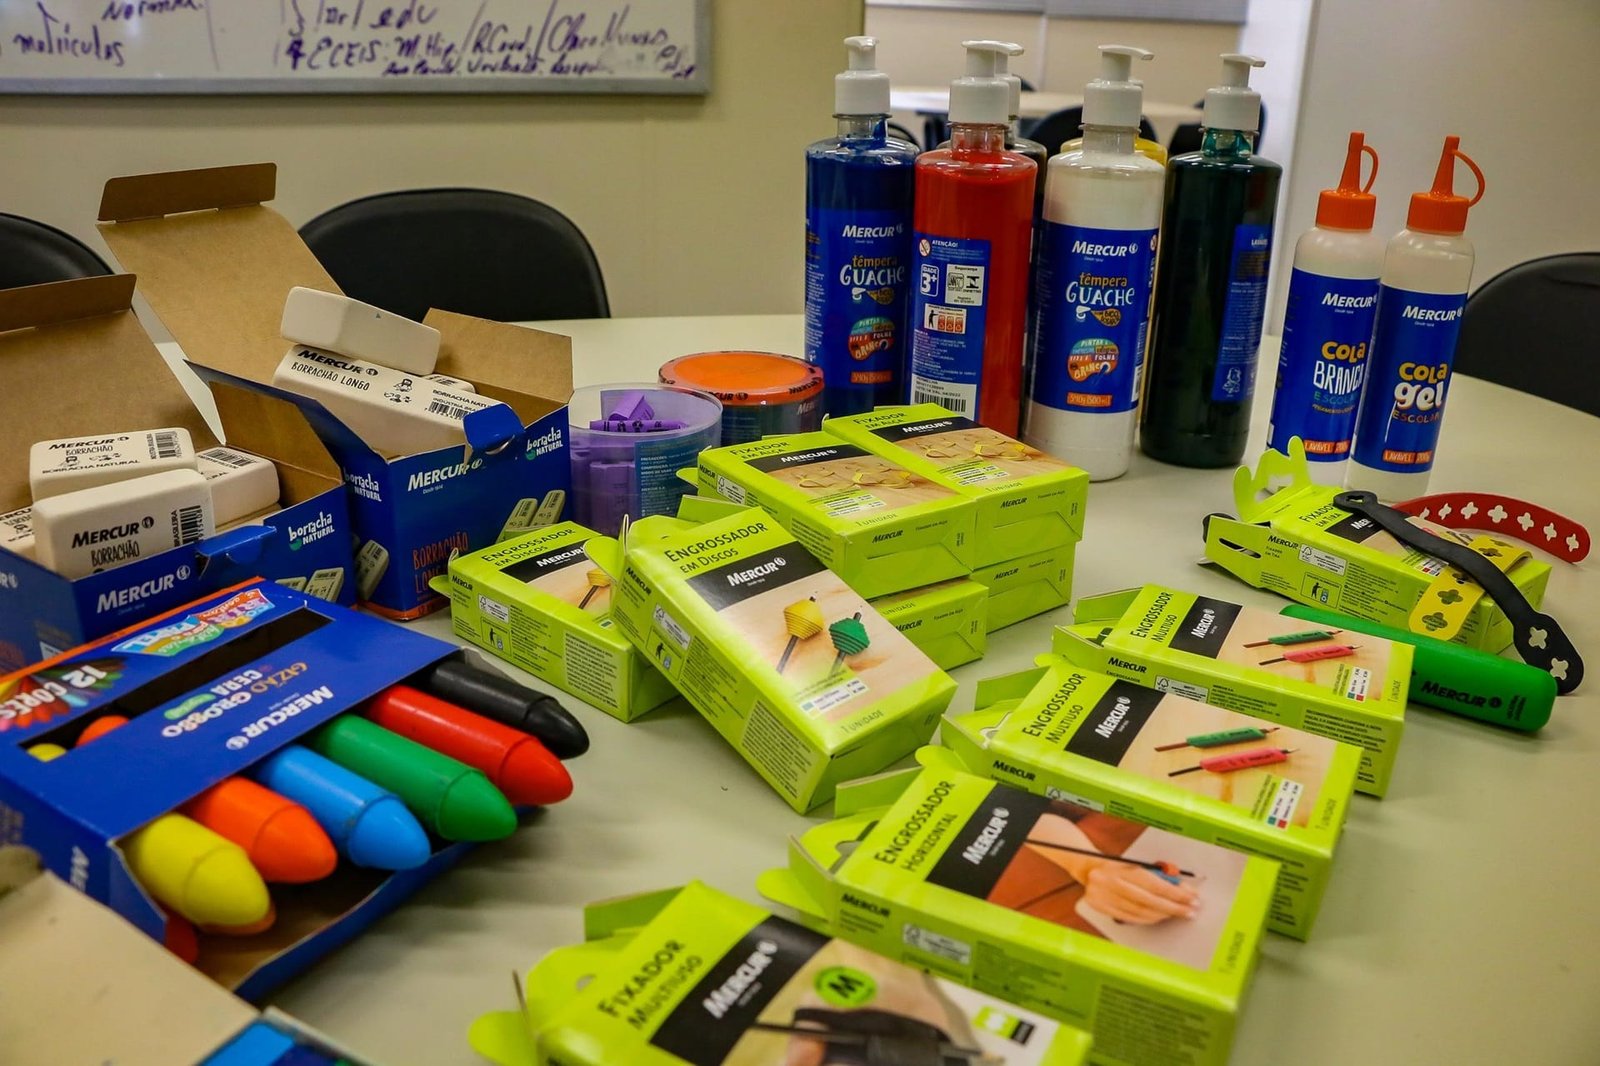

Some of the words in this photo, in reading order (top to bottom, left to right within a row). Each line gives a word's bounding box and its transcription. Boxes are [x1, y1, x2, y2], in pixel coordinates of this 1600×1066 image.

[842, 224, 895, 238] MERCUR
[1072, 240, 1127, 257] MERCUR
[1079, 272, 1127, 287] têmpera
[1322, 292, 1373, 308] MERCUR
[1402, 305, 1456, 321] MERCUR
[297, 350, 364, 375] MERCUR
[291, 362, 339, 384] BORRACHÃO
[340, 375, 371, 392] LONGO
[1394, 381, 1445, 411] gel
[853, 412, 907, 425] FIXADOR
[902, 421, 945, 434] MERCUR
[48, 438, 115, 450] MERCUR
[65, 445, 114, 456] BORRACHÃO
[526, 427, 562, 452] borracha
[536, 440, 564, 456] NATURAL
[729, 441, 790, 457] FIXADOR
[42, 464, 95, 474] BORRACHA
[96, 459, 141, 469] NATURAL
[780, 450, 829, 463] MERCUR
[407, 463, 470, 492] MERCUR
[354, 485, 382, 502] NATURAL
[1000, 497, 1028, 509] MERCUR
[1299, 503, 1334, 522] FIXADO
[71, 522, 140, 549] MERCUR
[288, 511, 333, 541] borracha
[302, 525, 335, 545] NATURAL
[871, 529, 904, 544] MERCUR
[91, 541, 141, 567] BORRACHÃO
[481, 527, 575, 562] ENGROSSADOR
[664, 521, 770, 563] ENGROSSADOR
[1268, 535, 1299, 550] MERCUR
[494, 557, 513, 568] EM
[514, 544, 549, 562] DISCOS
[679, 559, 699, 575] EM
[701, 547, 739, 569] DISCOS
[452, 575, 473, 591] MERCUR
[626, 567, 652, 596] MERCUR
[727, 562, 779, 587] MERCUR
[994, 568, 1019, 580] MERCUR
[96, 574, 175, 614] MERCUR
[1130, 591, 1174, 638] ENGROSSADOR
[1190, 611, 1215, 639] MERCUR
[1152, 614, 1178, 643] MULTIUSO
[62, 665, 108, 689] 12
[1108, 657, 1147, 674] MERCUR
[210, 669, 262, 695] CERA
[1421, 680, 1487, 708] MERCUR
[241, 685, 335, 740] MERCUR
[1022, 673, 1087, 737] ENGROSSADOR
[1046, 704, 1084, 744] MULTIUSO
[1095, 703, 1130, 739] MERCUR
[993, 760, 1036, 781] MERCUR
[873, 780, 955, 866] ENGROSSADOR
[900, 812, 957, 873] HORIZONTAL
[962, 814, 1008, 866] MERCUR
[841, 892, 891, 918] MERCUR
[597, 938, 687, 1019] FIXADOR
[703, 948, 773, 1019] MERCUR
[828, 975, 863, 998] M
[627, 954, 704, 1032] MULTIUSO
